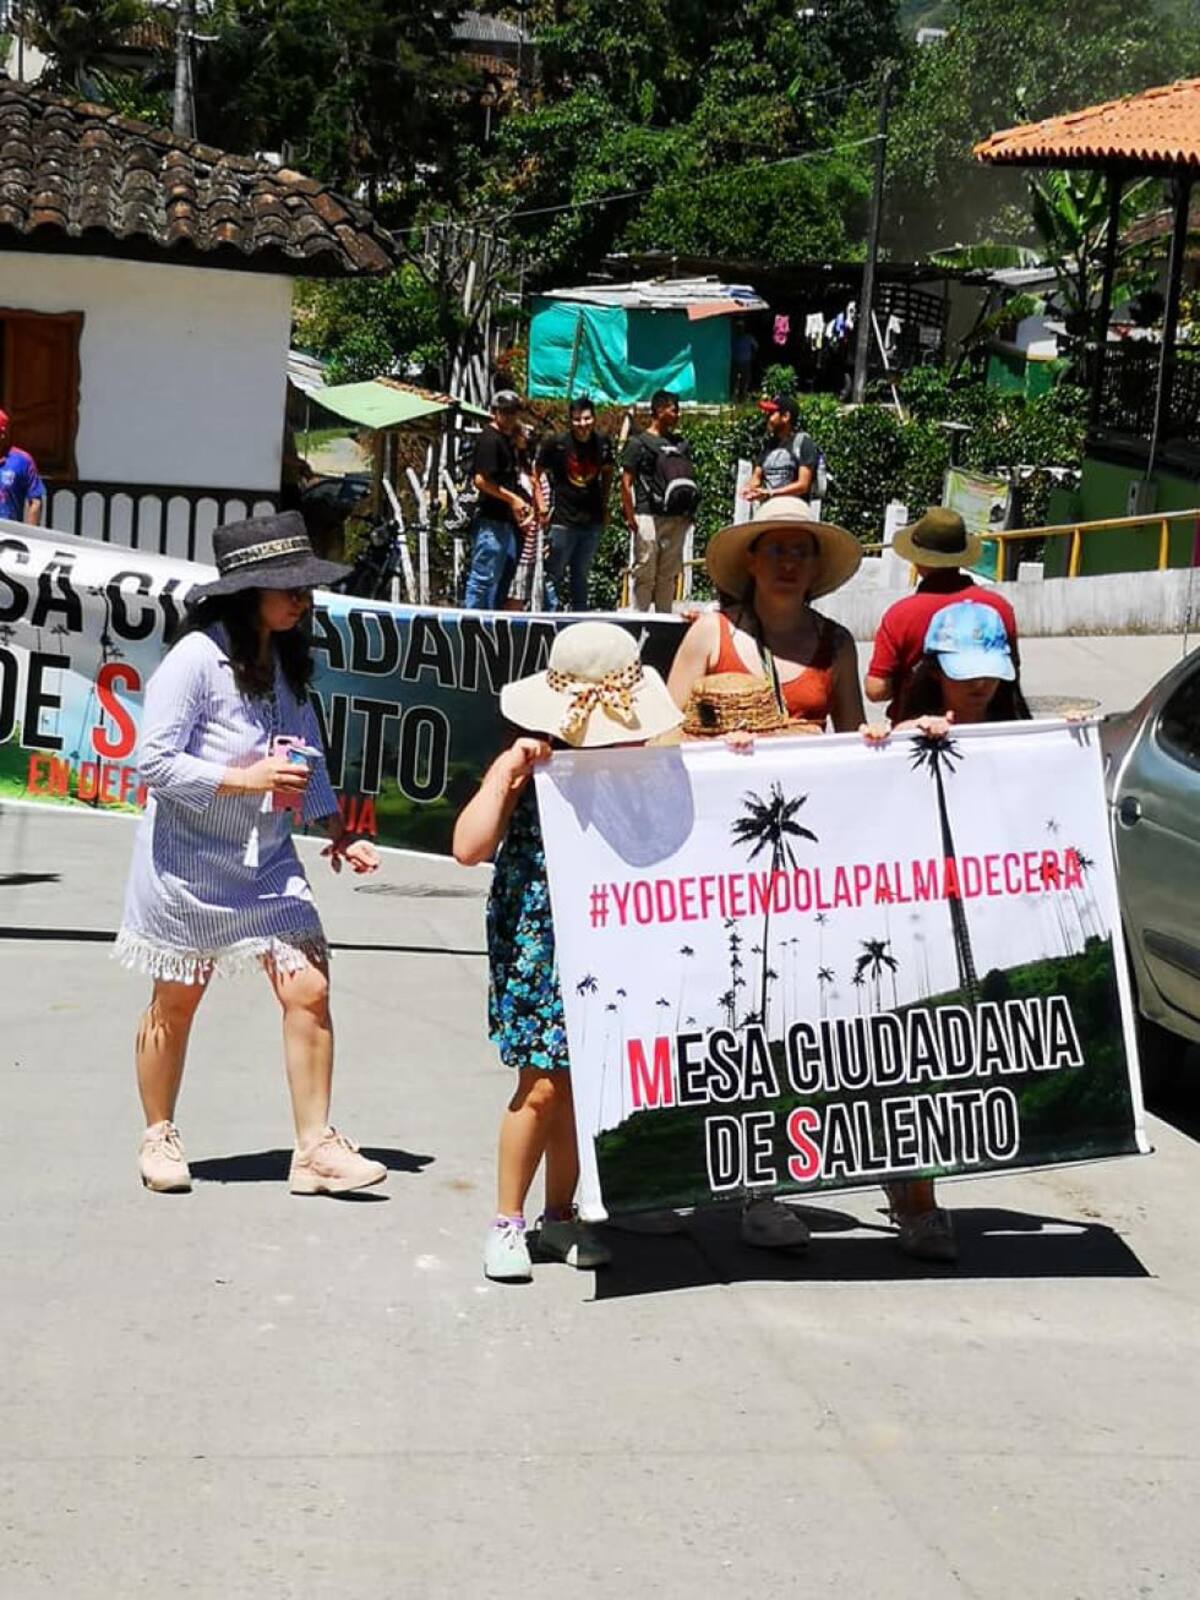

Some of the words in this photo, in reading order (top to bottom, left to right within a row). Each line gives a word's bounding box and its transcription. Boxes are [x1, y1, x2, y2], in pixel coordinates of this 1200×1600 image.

[28, 753, 70, 797] EN
[589, 847, 1084, 928] #YODEFIENDOLAPALMADECERA
[626, 1025, 779, 1110] MESA
[785, 995, 1084, 1096] CIUDADANA
[705, 1110, 777, 1191] DE
[787, 1086, 1020, 1182] SALENTO
